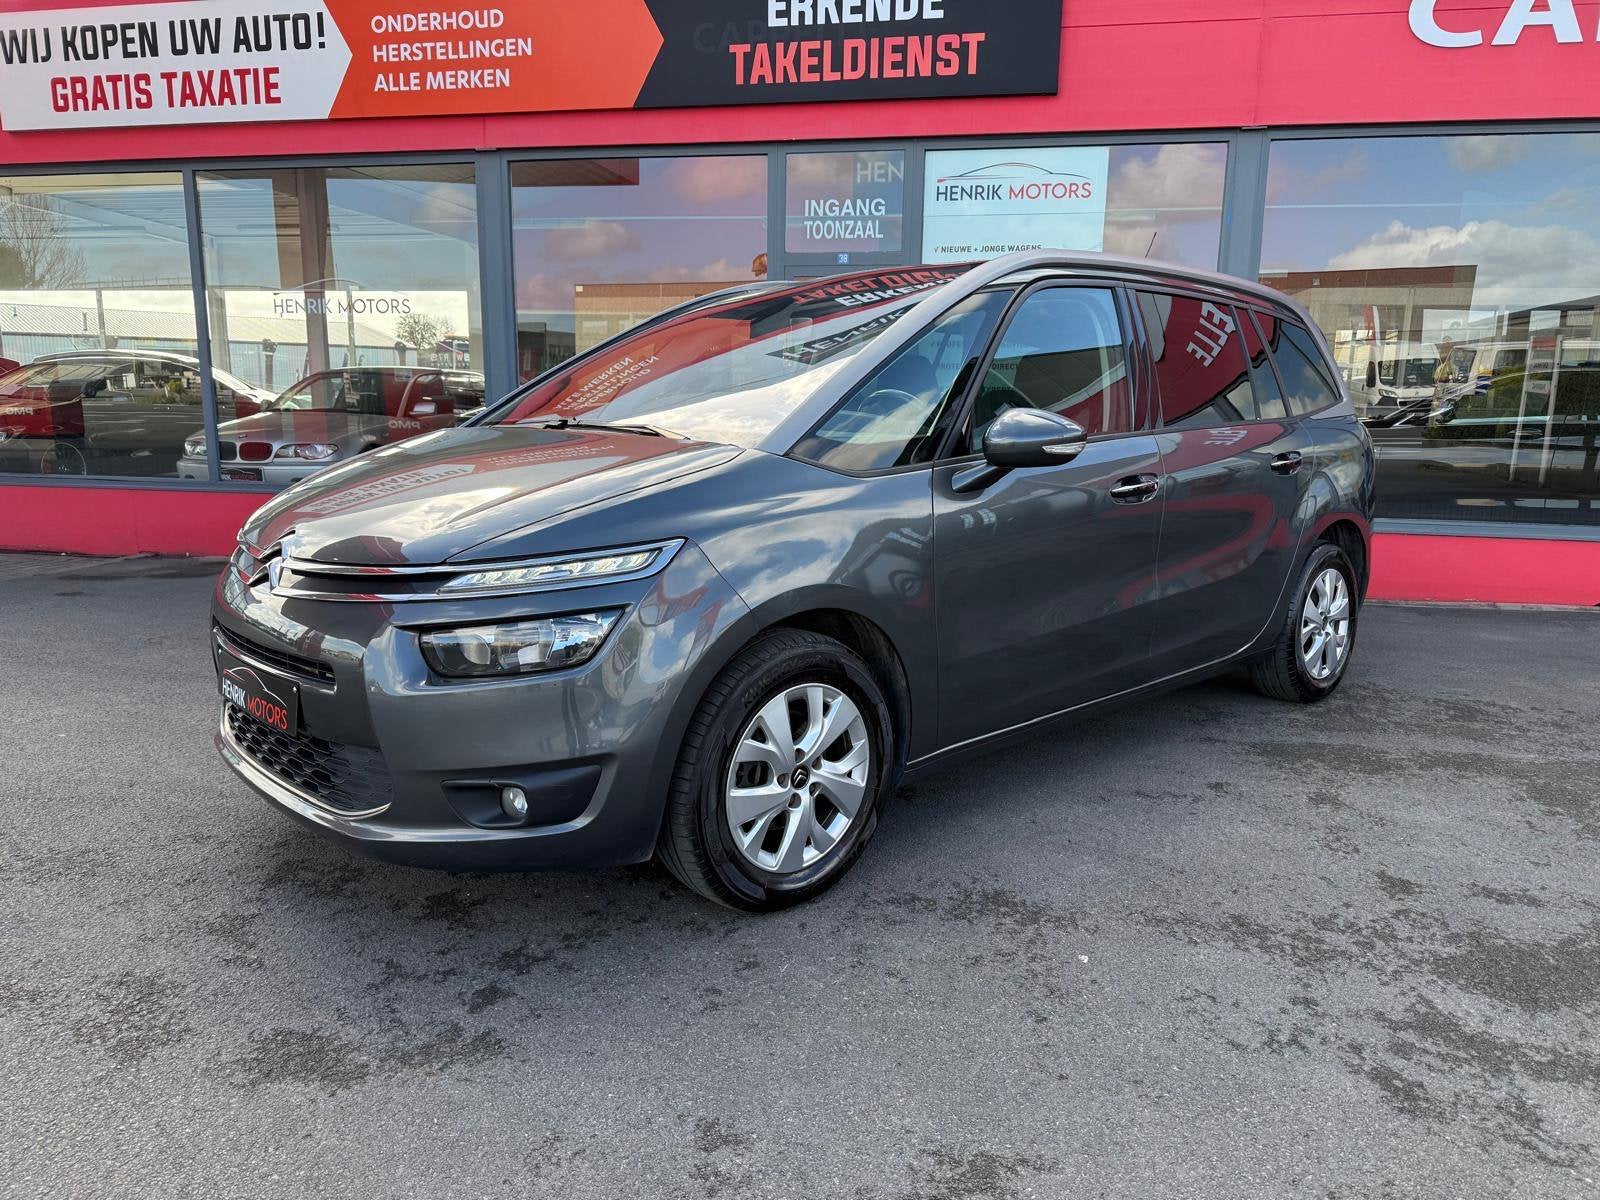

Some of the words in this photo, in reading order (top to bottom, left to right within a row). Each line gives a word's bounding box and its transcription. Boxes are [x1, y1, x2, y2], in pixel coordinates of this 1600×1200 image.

[370, 8, 504, 33] ONDERHOUD
[767, 0, 944, 27] ERKENDE
[1408, 0, 1600, 47] CA
[0, 27, 51, 65] WIJ
[61, 20, 159, 61] KOPEN
[168, 17, 221, 56] UW
[233, 11, 326, 53] AUTO!
[372, 37, 533, 63] HERSTELLINGEN
[729, 32, 986, 85] TAKELDIENST
[50, 73, 153, 113] GRATIS
[160, 66, 282, 108] TAXATIE
[374, 72, 421, 92] ALLE
[426, 68, 510, 90] MERKEN
[936, 184, 1003, 201] HENRIK
[1008, 182, 1092, 200] MOTORS
[804, 198, 886, 217] INGANG
[804, 219, 884, 239] TOONZAAL
[941, 245, 972, 253] NIEUWE
[980, 245, 1006, 253] JONGE
[273, 298, 333, 314] HENRIK
[338, 298, 411, 314] MOTORS
[222, 676, 246, 709] HENRIK
[247, 696, 288, 731] MOTORS
